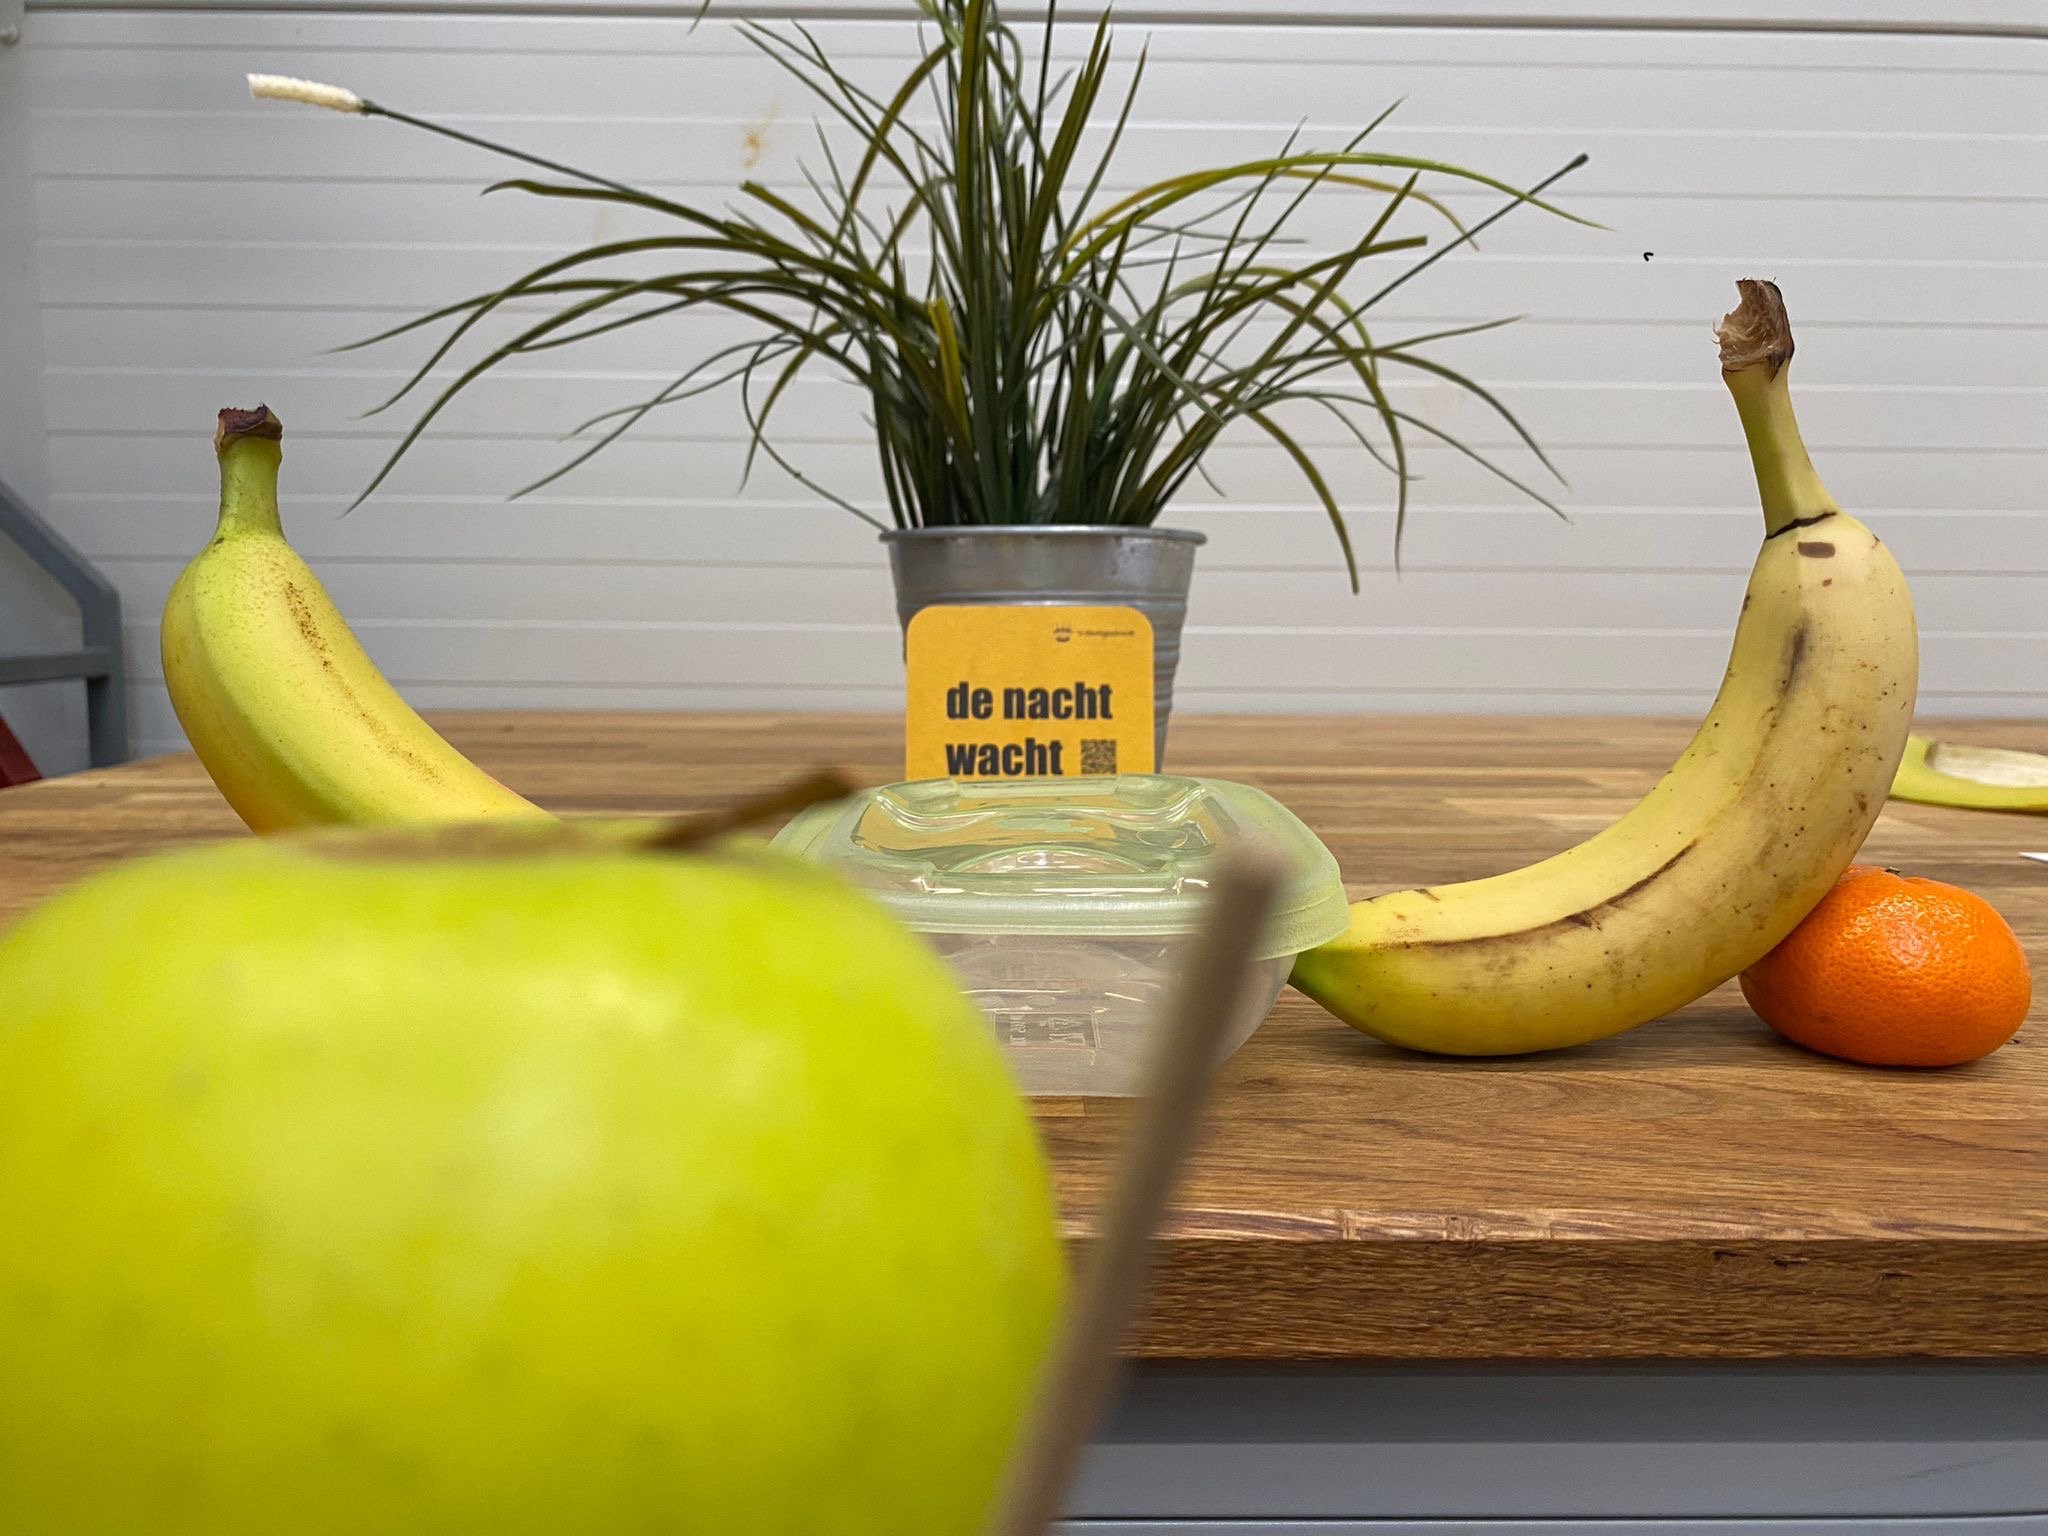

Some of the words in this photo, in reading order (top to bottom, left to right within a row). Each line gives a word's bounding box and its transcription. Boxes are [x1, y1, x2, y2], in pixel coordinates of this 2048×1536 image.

[946, 681, 993, 720] de
[1003, 681, 1113, 720] nacht
[945, 737, 1063, 776] wacht
